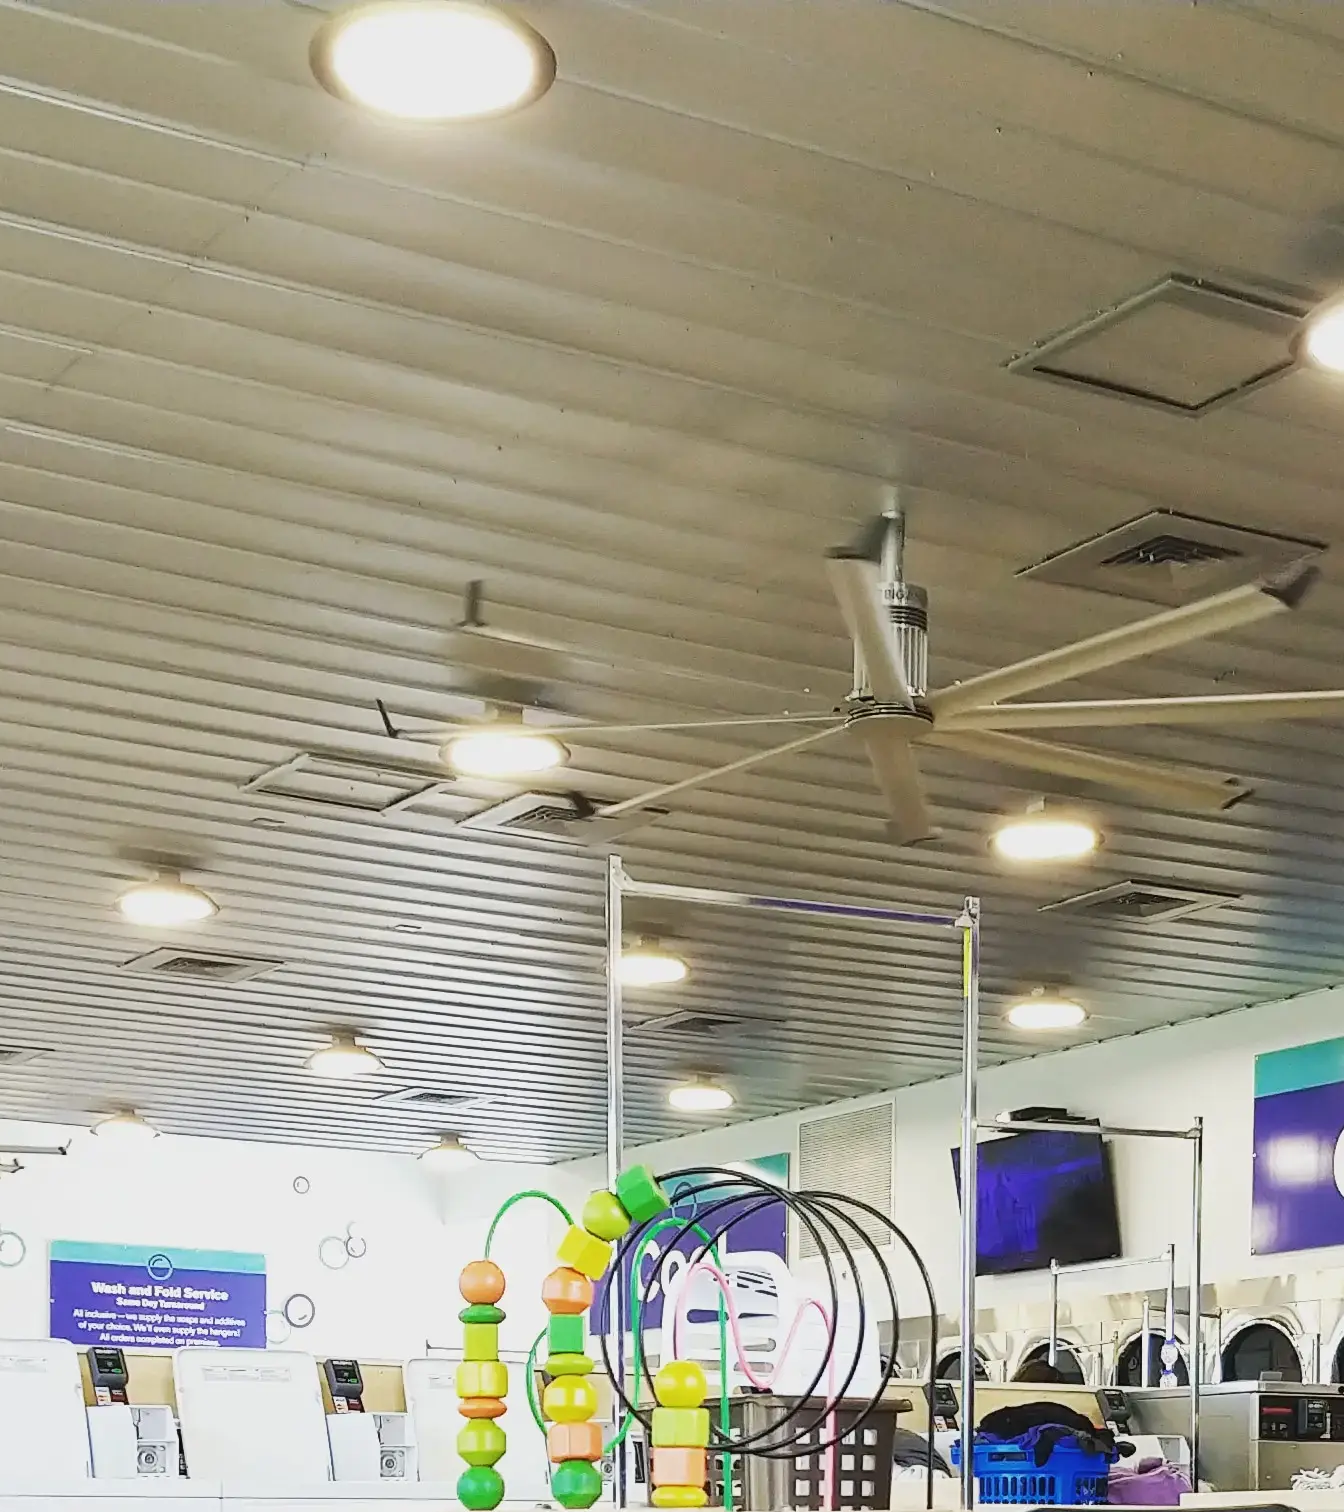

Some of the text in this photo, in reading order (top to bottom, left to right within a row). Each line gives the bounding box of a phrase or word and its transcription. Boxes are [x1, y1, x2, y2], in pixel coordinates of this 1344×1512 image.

[91, 1281, 230, 1301] Wash and Fold Service
[116, 1297, 141, 1306] Same
[142, 1299, 159, 1309] Day
